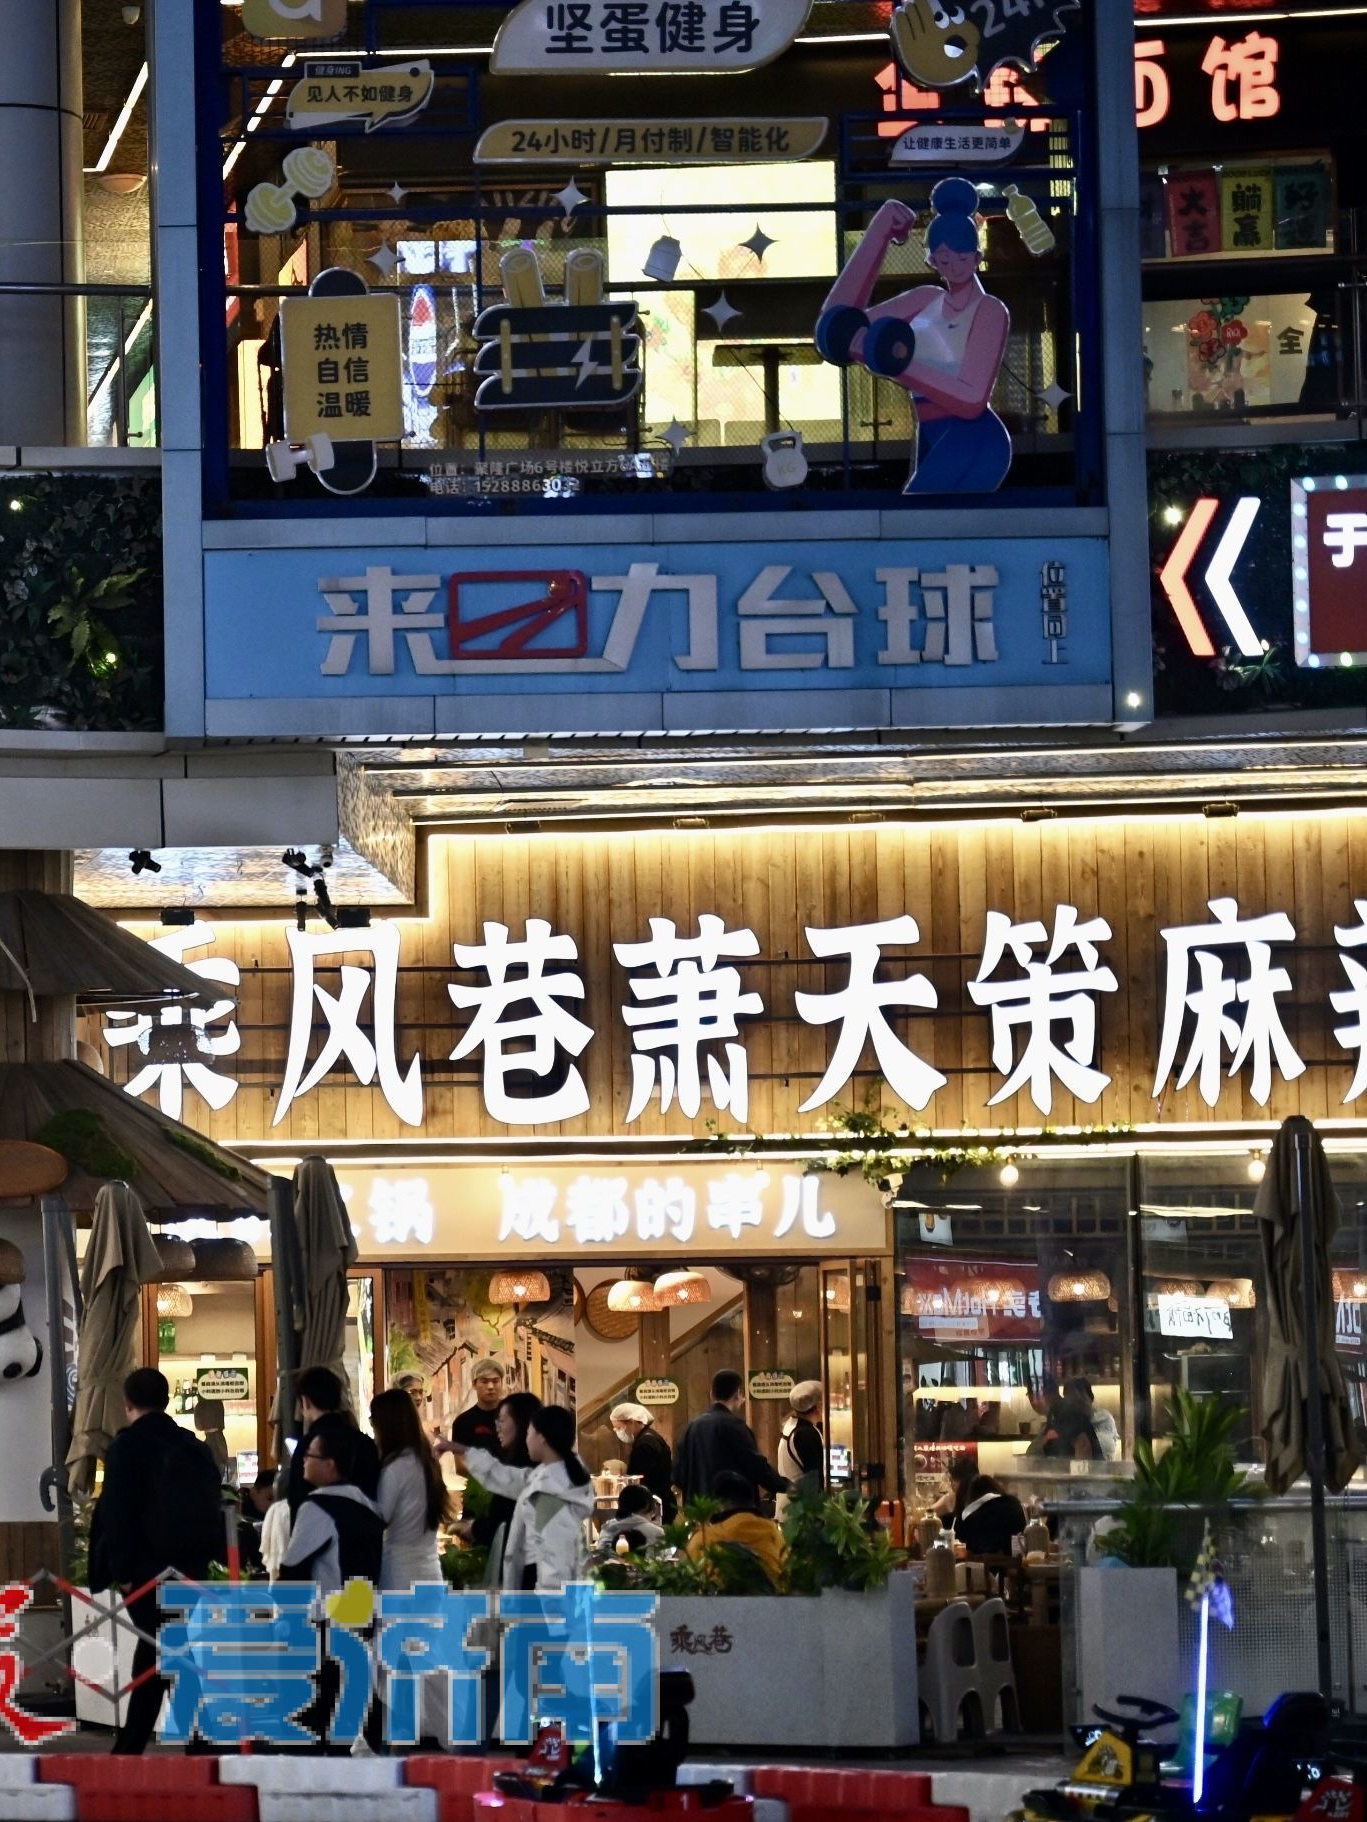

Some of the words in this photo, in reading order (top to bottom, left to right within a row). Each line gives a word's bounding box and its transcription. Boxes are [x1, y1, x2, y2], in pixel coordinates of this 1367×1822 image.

[545, 1, 760, 54] 坚蛋健身
[307, 85, 413, 103] 见人不如健身
[511, 126, 790, 154] 24小时/月付制/智能化
[903, 136, 1011, 150] 让健康生活更简单
[314, 323, 368, 351] 热情
[316, 357, 369, 384] 自信
[316, 391, 371, 418] 温暖
[103, 897, 1367, 1127] 乘风巷萧天策麻
